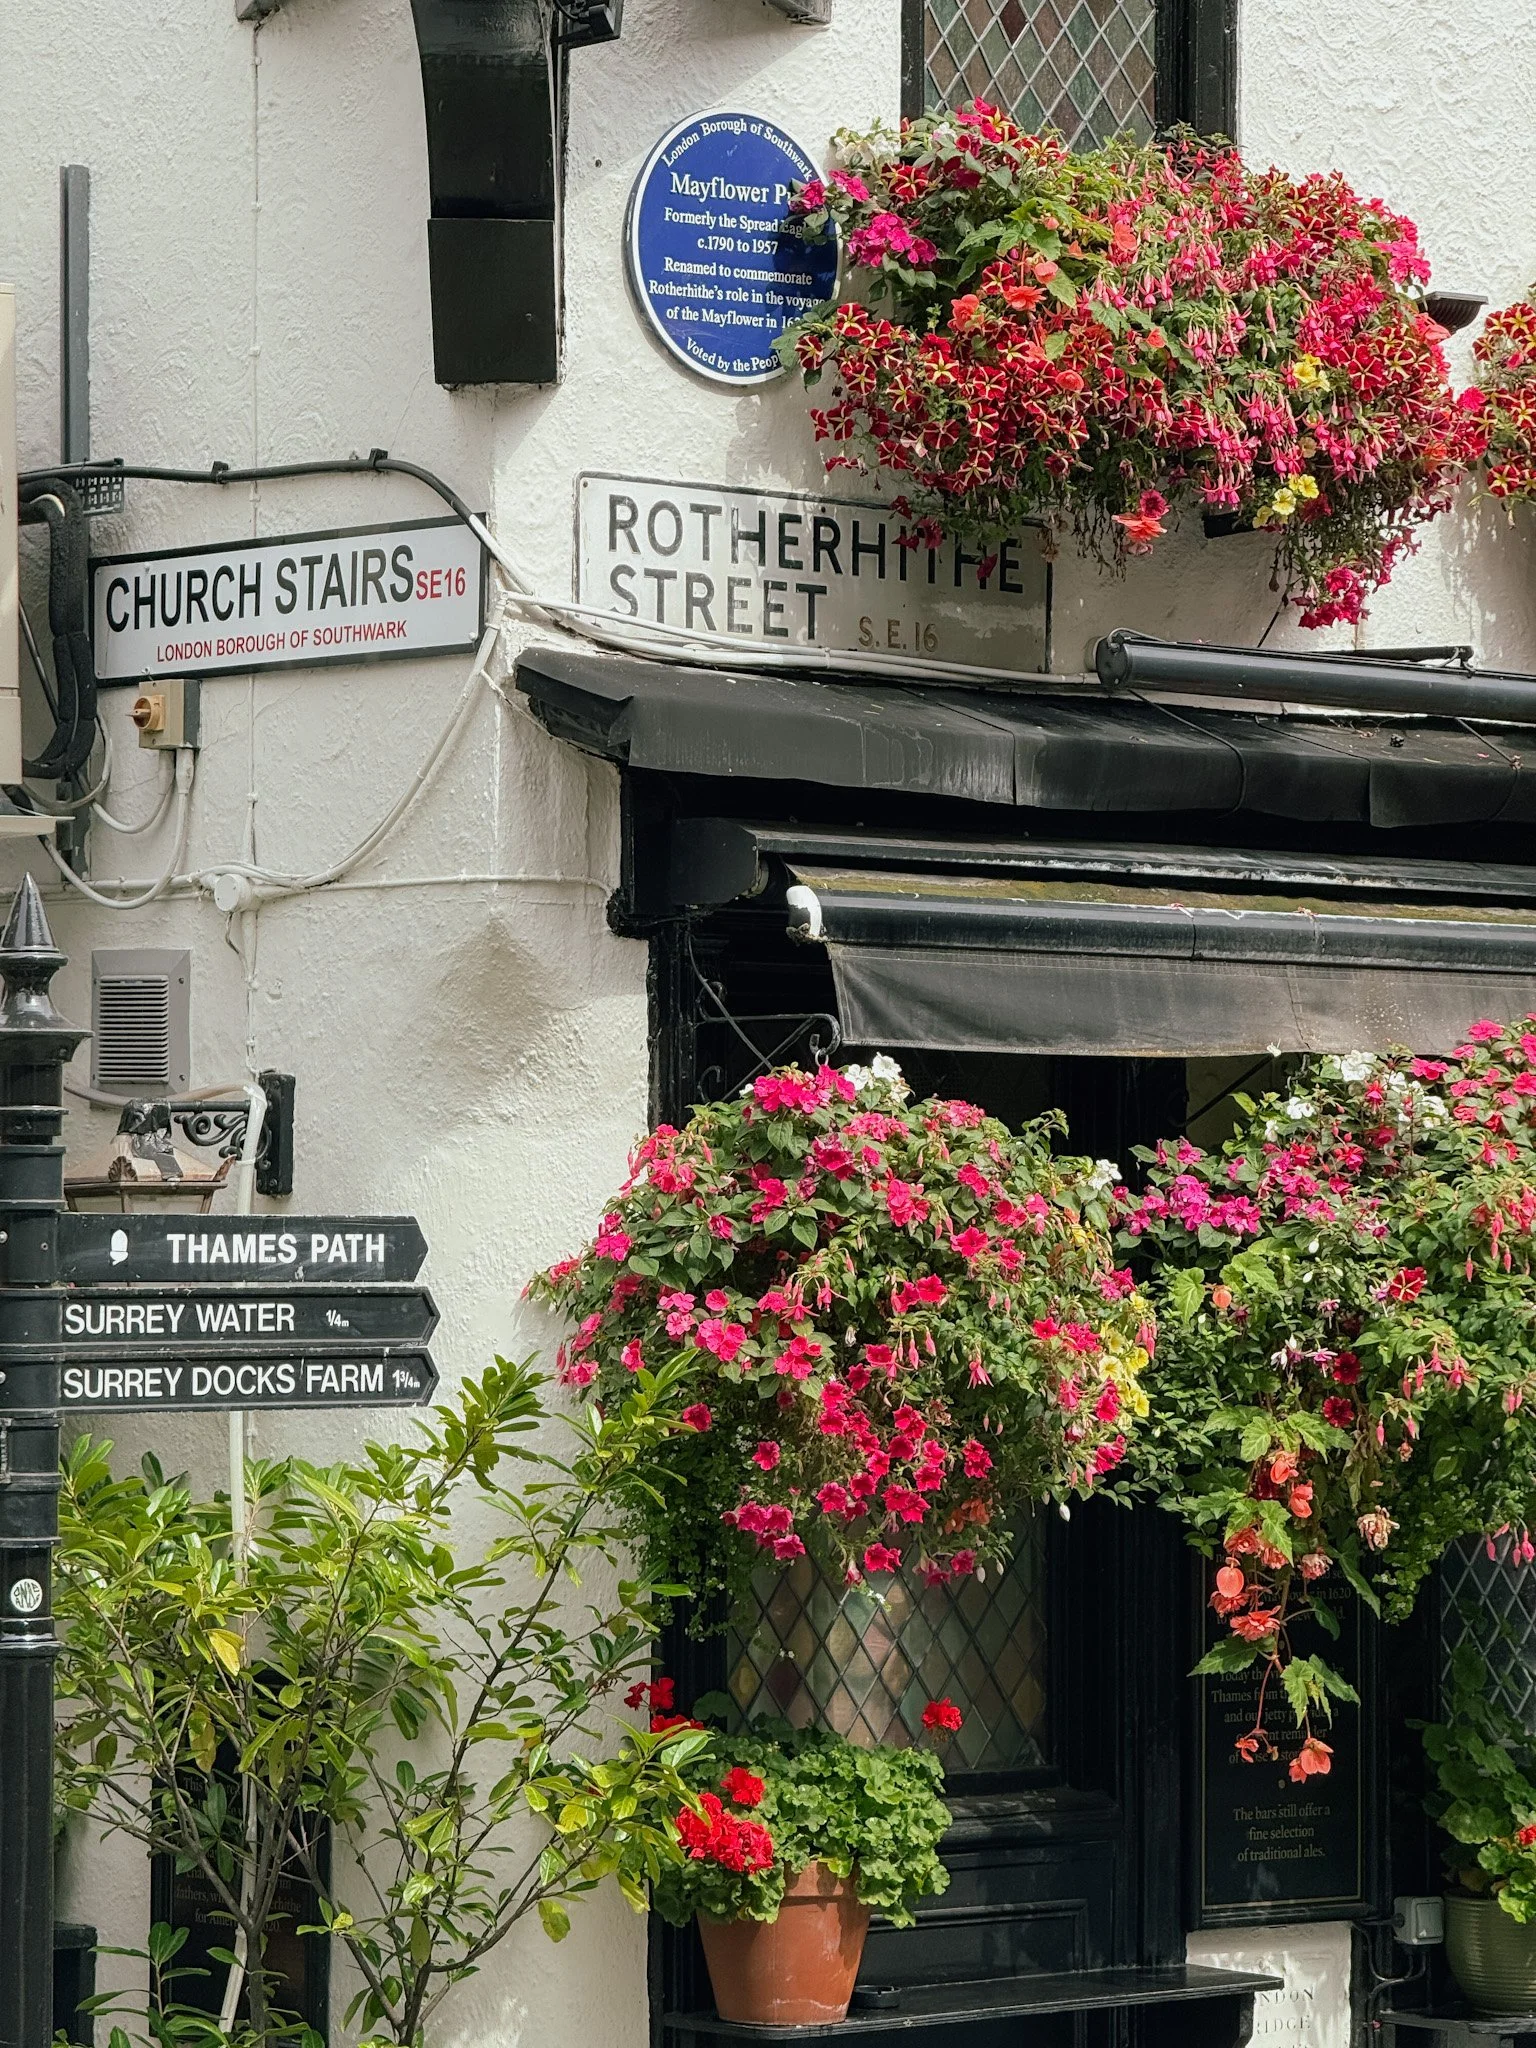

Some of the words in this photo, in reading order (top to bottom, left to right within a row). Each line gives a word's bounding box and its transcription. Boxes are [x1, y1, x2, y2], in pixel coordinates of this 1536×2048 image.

[661, 132, 700, 167] London
[700, 118, 747, 137] Borough
[750, 123, 764, 136] of
[763, 127, 815, 182] Southwark
[670, 172, 770, 203] Mayflower
[663, 207, 717, 230] Formerly
[718, 213, 737, 228] the
[739, 216, 778, 234] Spread
[780, 219, 807, 239] Eag
[697, 236, 734, 251] c.1790
[736, 239, 750, 253] to
[751, 239, 779, 255] 1957
[664, 257, 717, 276] Renamed
[718, 264, 731, 277] to
[733, 268, 813, 286] commemorate
[649, 280, 724, 301] Rotherhithe's
[725, 288, 749, 302] role
[751, 289, 763, 304] in
[765, 291, 784, 306] the
[666, 306, 679, 320] of
[681, 306, 699, 321] the
[701, 308, 765, 328] Mayflower
[765, 313, 777, 329] in
[686, 337, 715, 366] Voted
[717, 356, 731, 372] by
[732, 358, 750, 372] the
[750, 354, 779, 371] Peop
[106, 561, 262, 633] CHURCH
[275, 545, 414, 614] STAIRS
[416, 567, 466, 600] SE16
[609, 564, 827, 640] STREET
[157, 640, 213, 663] LONDON
[216, 632, 285, 656] BOROUGH
[290, 629, 308, 648] OF
[313, 620, 408, 647] SOUTHWARK
[167, 1233, 298, 1264] THAMES
[311, 1233, 385, 1263] PATH
[64, 1303, 185, 1335] SURREY
[195, 1303, 295, 1332] WATER
[63, 1366, 184, 1398] SURREY
[192, 1364, 296, 1396] DOCKS
[306, 1364, 384, 1393] FARM
[1328, 1587, 1351, 1601] 1620
[1211, 1687, 1252, 1703] Thames
[1223, 1709, 1243, 1723] and
[1245, 1711, 1260, 1722] ou
[1264, 1707, 1288, 1724] jetty
[1233, 1806, 1254, 1821] The
[1255, 1806, 1276, 1820] bars
[1278, 1804, 1297, 1818] still
[1299, 1802, 1321, 1817] offer
[1323, 1805, 1331, 1816] a
[1249, 1826, 1268, 1841] fine
[1270, 1824, 1314, 1840] selection
[1237, 1847, 1250, 1862] of
[1250, 1844, 1302, 1861] traditional
[1304, 1843, 1327, 1858] ales.
